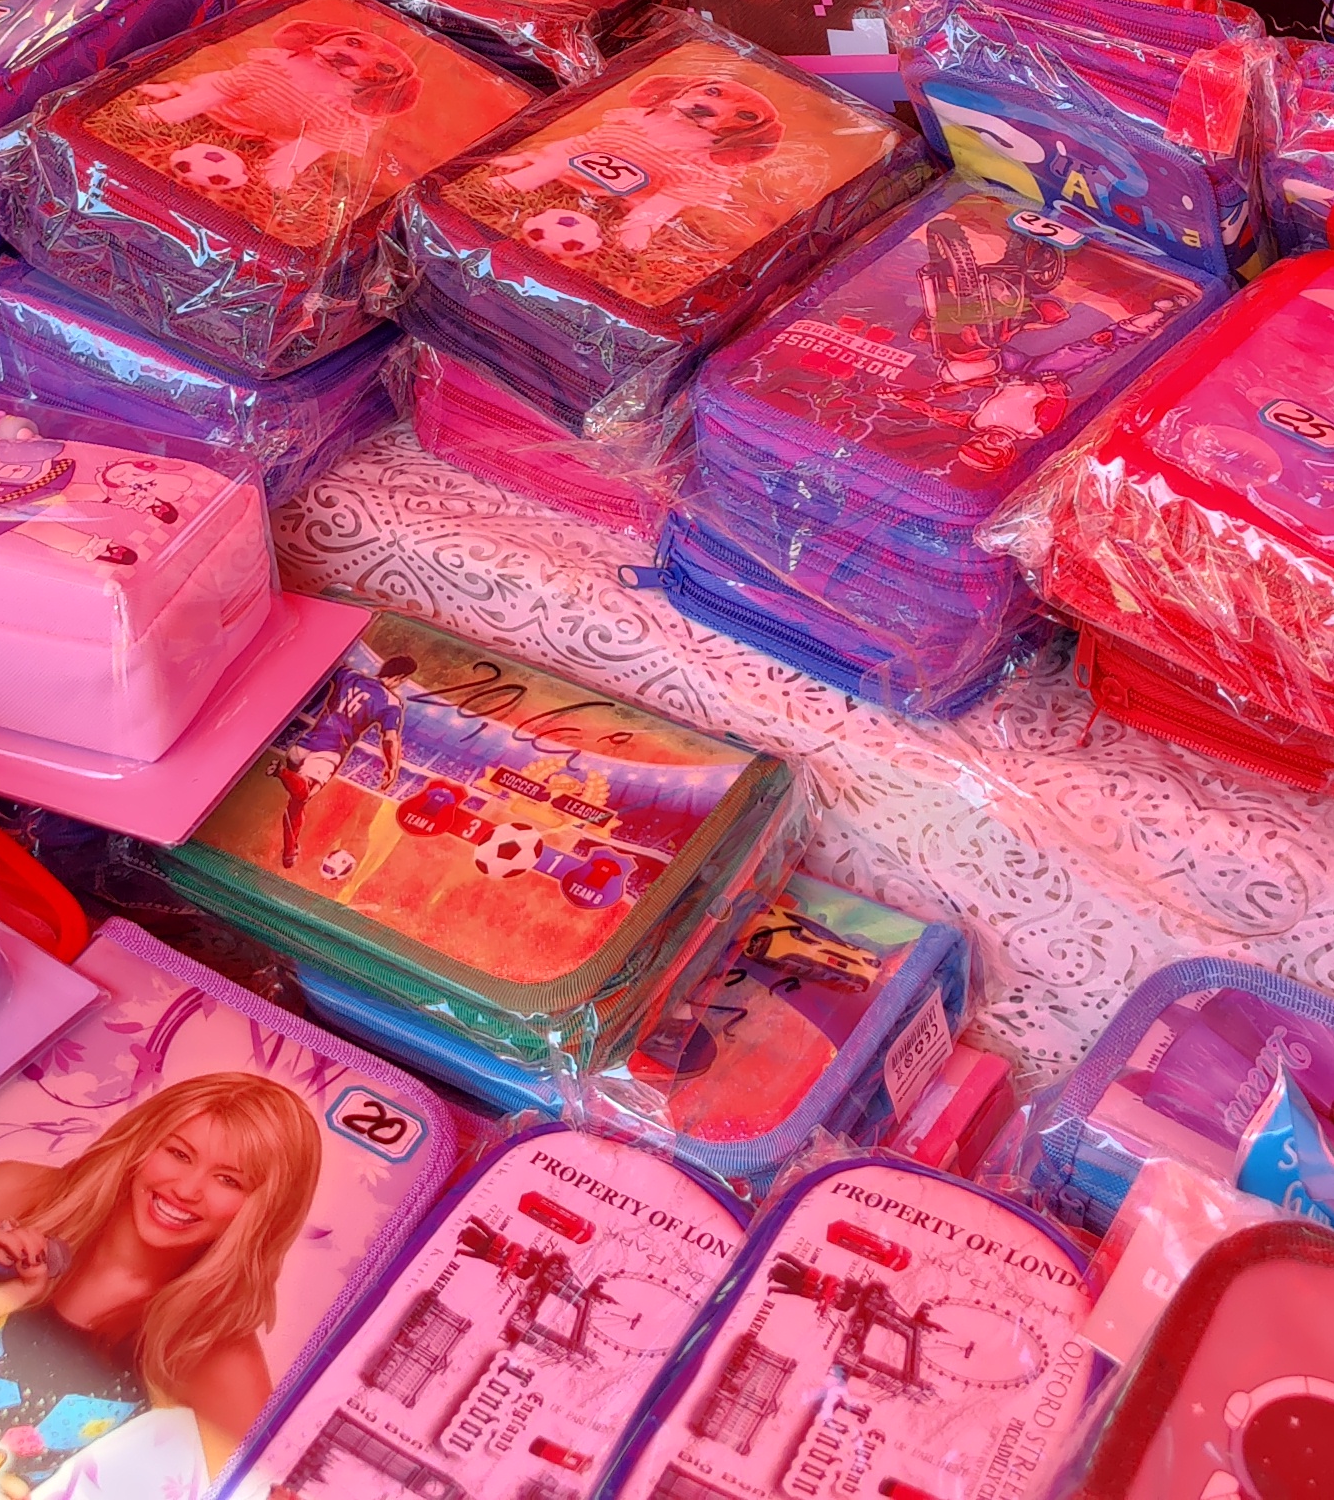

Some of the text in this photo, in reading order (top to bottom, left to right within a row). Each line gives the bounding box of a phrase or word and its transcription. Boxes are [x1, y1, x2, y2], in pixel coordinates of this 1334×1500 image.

[581, 156, 637, 180] 25
[1062, 170, 1202, 250] Aloha
[1020, 214, 1065, 237] 25
[772, 332, 903, 382] MOTOCROSS
[499, 771, 540, 798] SOCCER
[403, 812, 436, 834] TEAM A
[563, 799, 606, 825] LEAGUE
[462, 818, 482, 838] 3
[547, 853, 564, 874] 1
[569, 882, 605, 905] TEAM B
[342, 1100, 408, 1146] 20
[528, 1150, 649, 1220] PROPERTY
[647, 1210, 682, 1235] OF
[830, 1181, 966, 1242] PROPERTY
[966, 1231, 1004, 1257] OF
[1033, 1340, 1085, 1429] OXFORD
